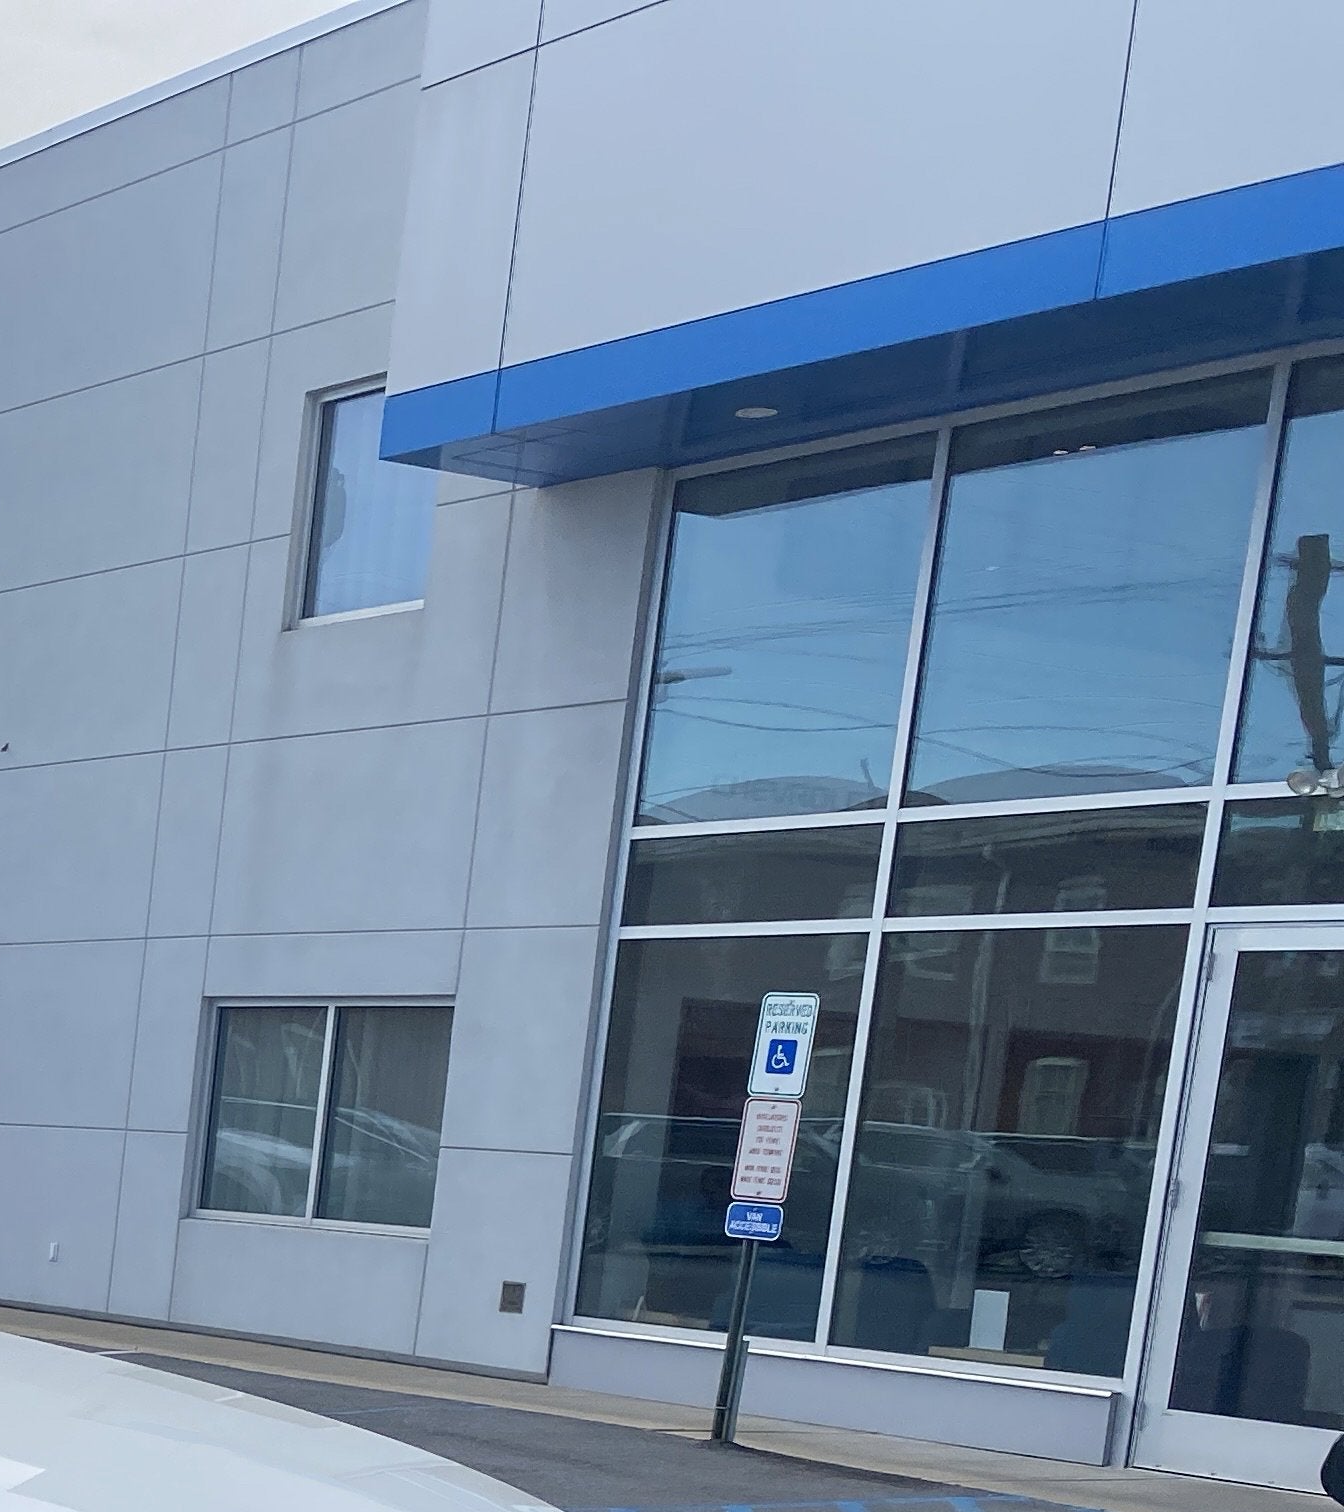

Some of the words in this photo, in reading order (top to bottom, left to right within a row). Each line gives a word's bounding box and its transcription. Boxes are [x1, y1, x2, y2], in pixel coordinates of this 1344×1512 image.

[766, 1003, 813, 1018] RESERVED
[765, 1020, 809, 1035] PARKING
[746, 1211, 763, 1222] VAN
